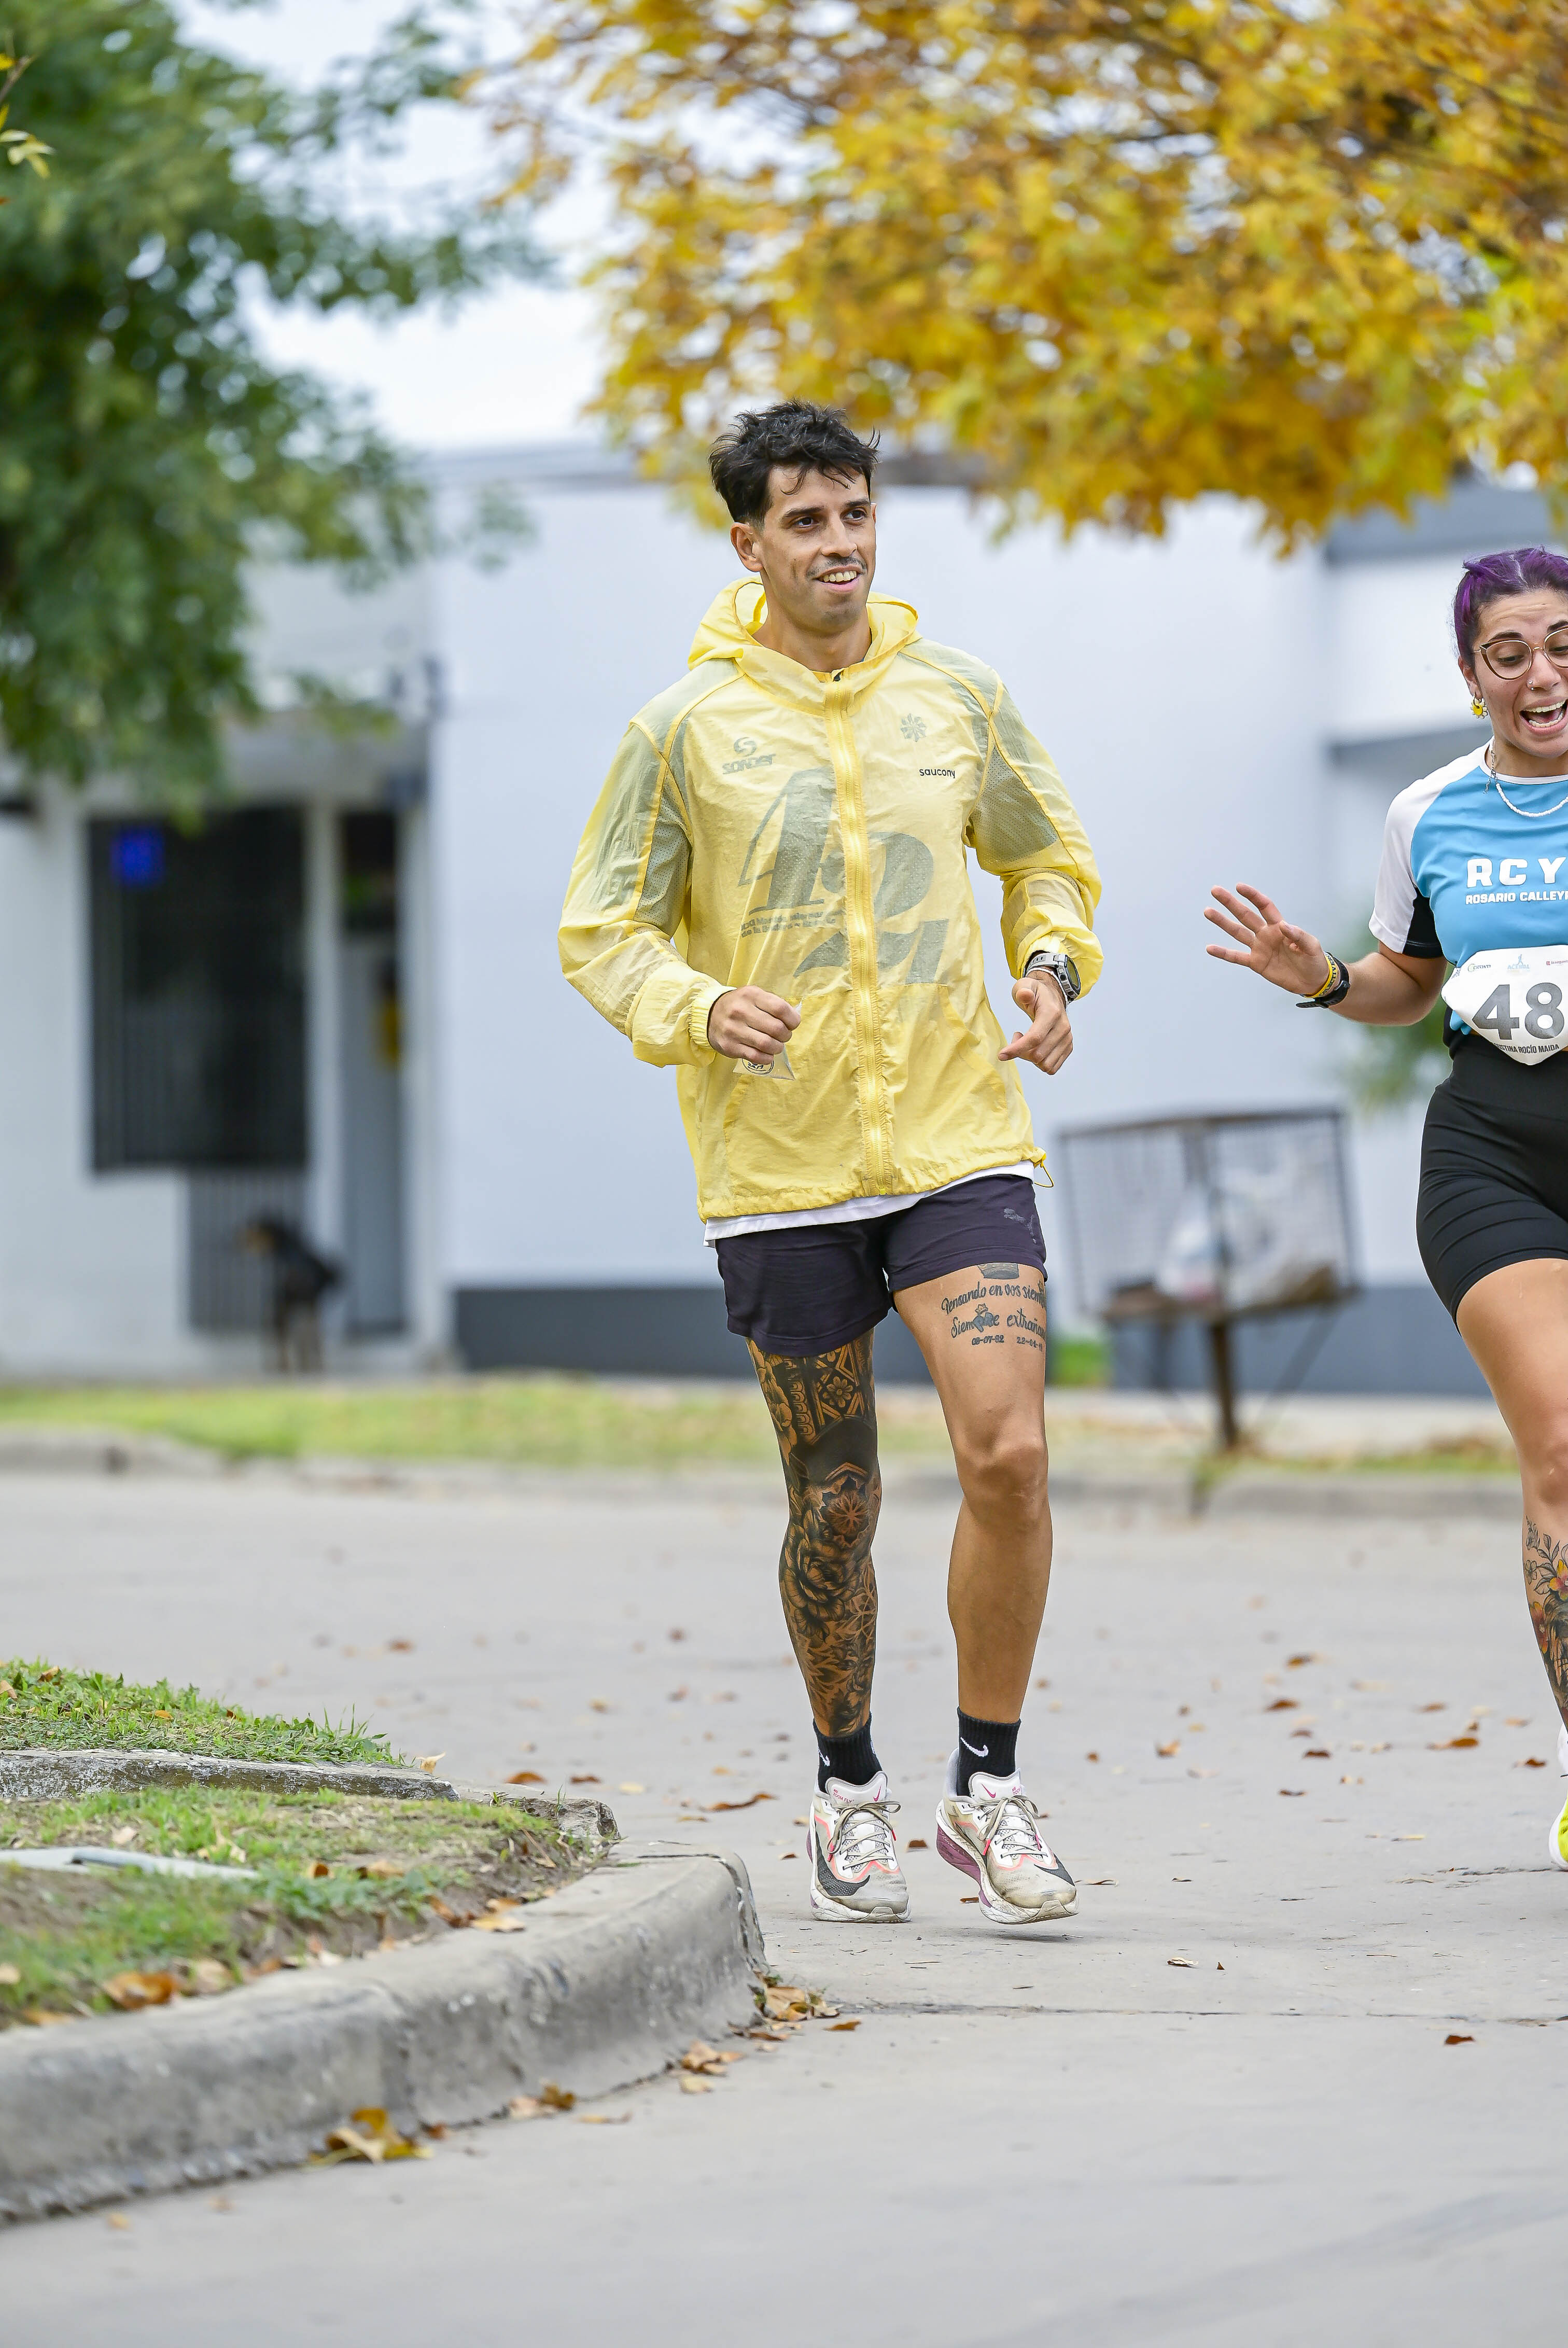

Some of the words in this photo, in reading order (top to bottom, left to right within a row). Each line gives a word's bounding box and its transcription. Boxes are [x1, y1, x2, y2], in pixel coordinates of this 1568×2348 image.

[919, 768, 955, 779] saucony
[1465, 892, 1516, 905] ROSARIO
[1472, 983, 1565, 1040] 48
[1518, 1044, 1537, 1054] ROCÍO
[1538, 1044, 1560, 1053] MAIDA
[989, 1285, 1003, 1296] en
